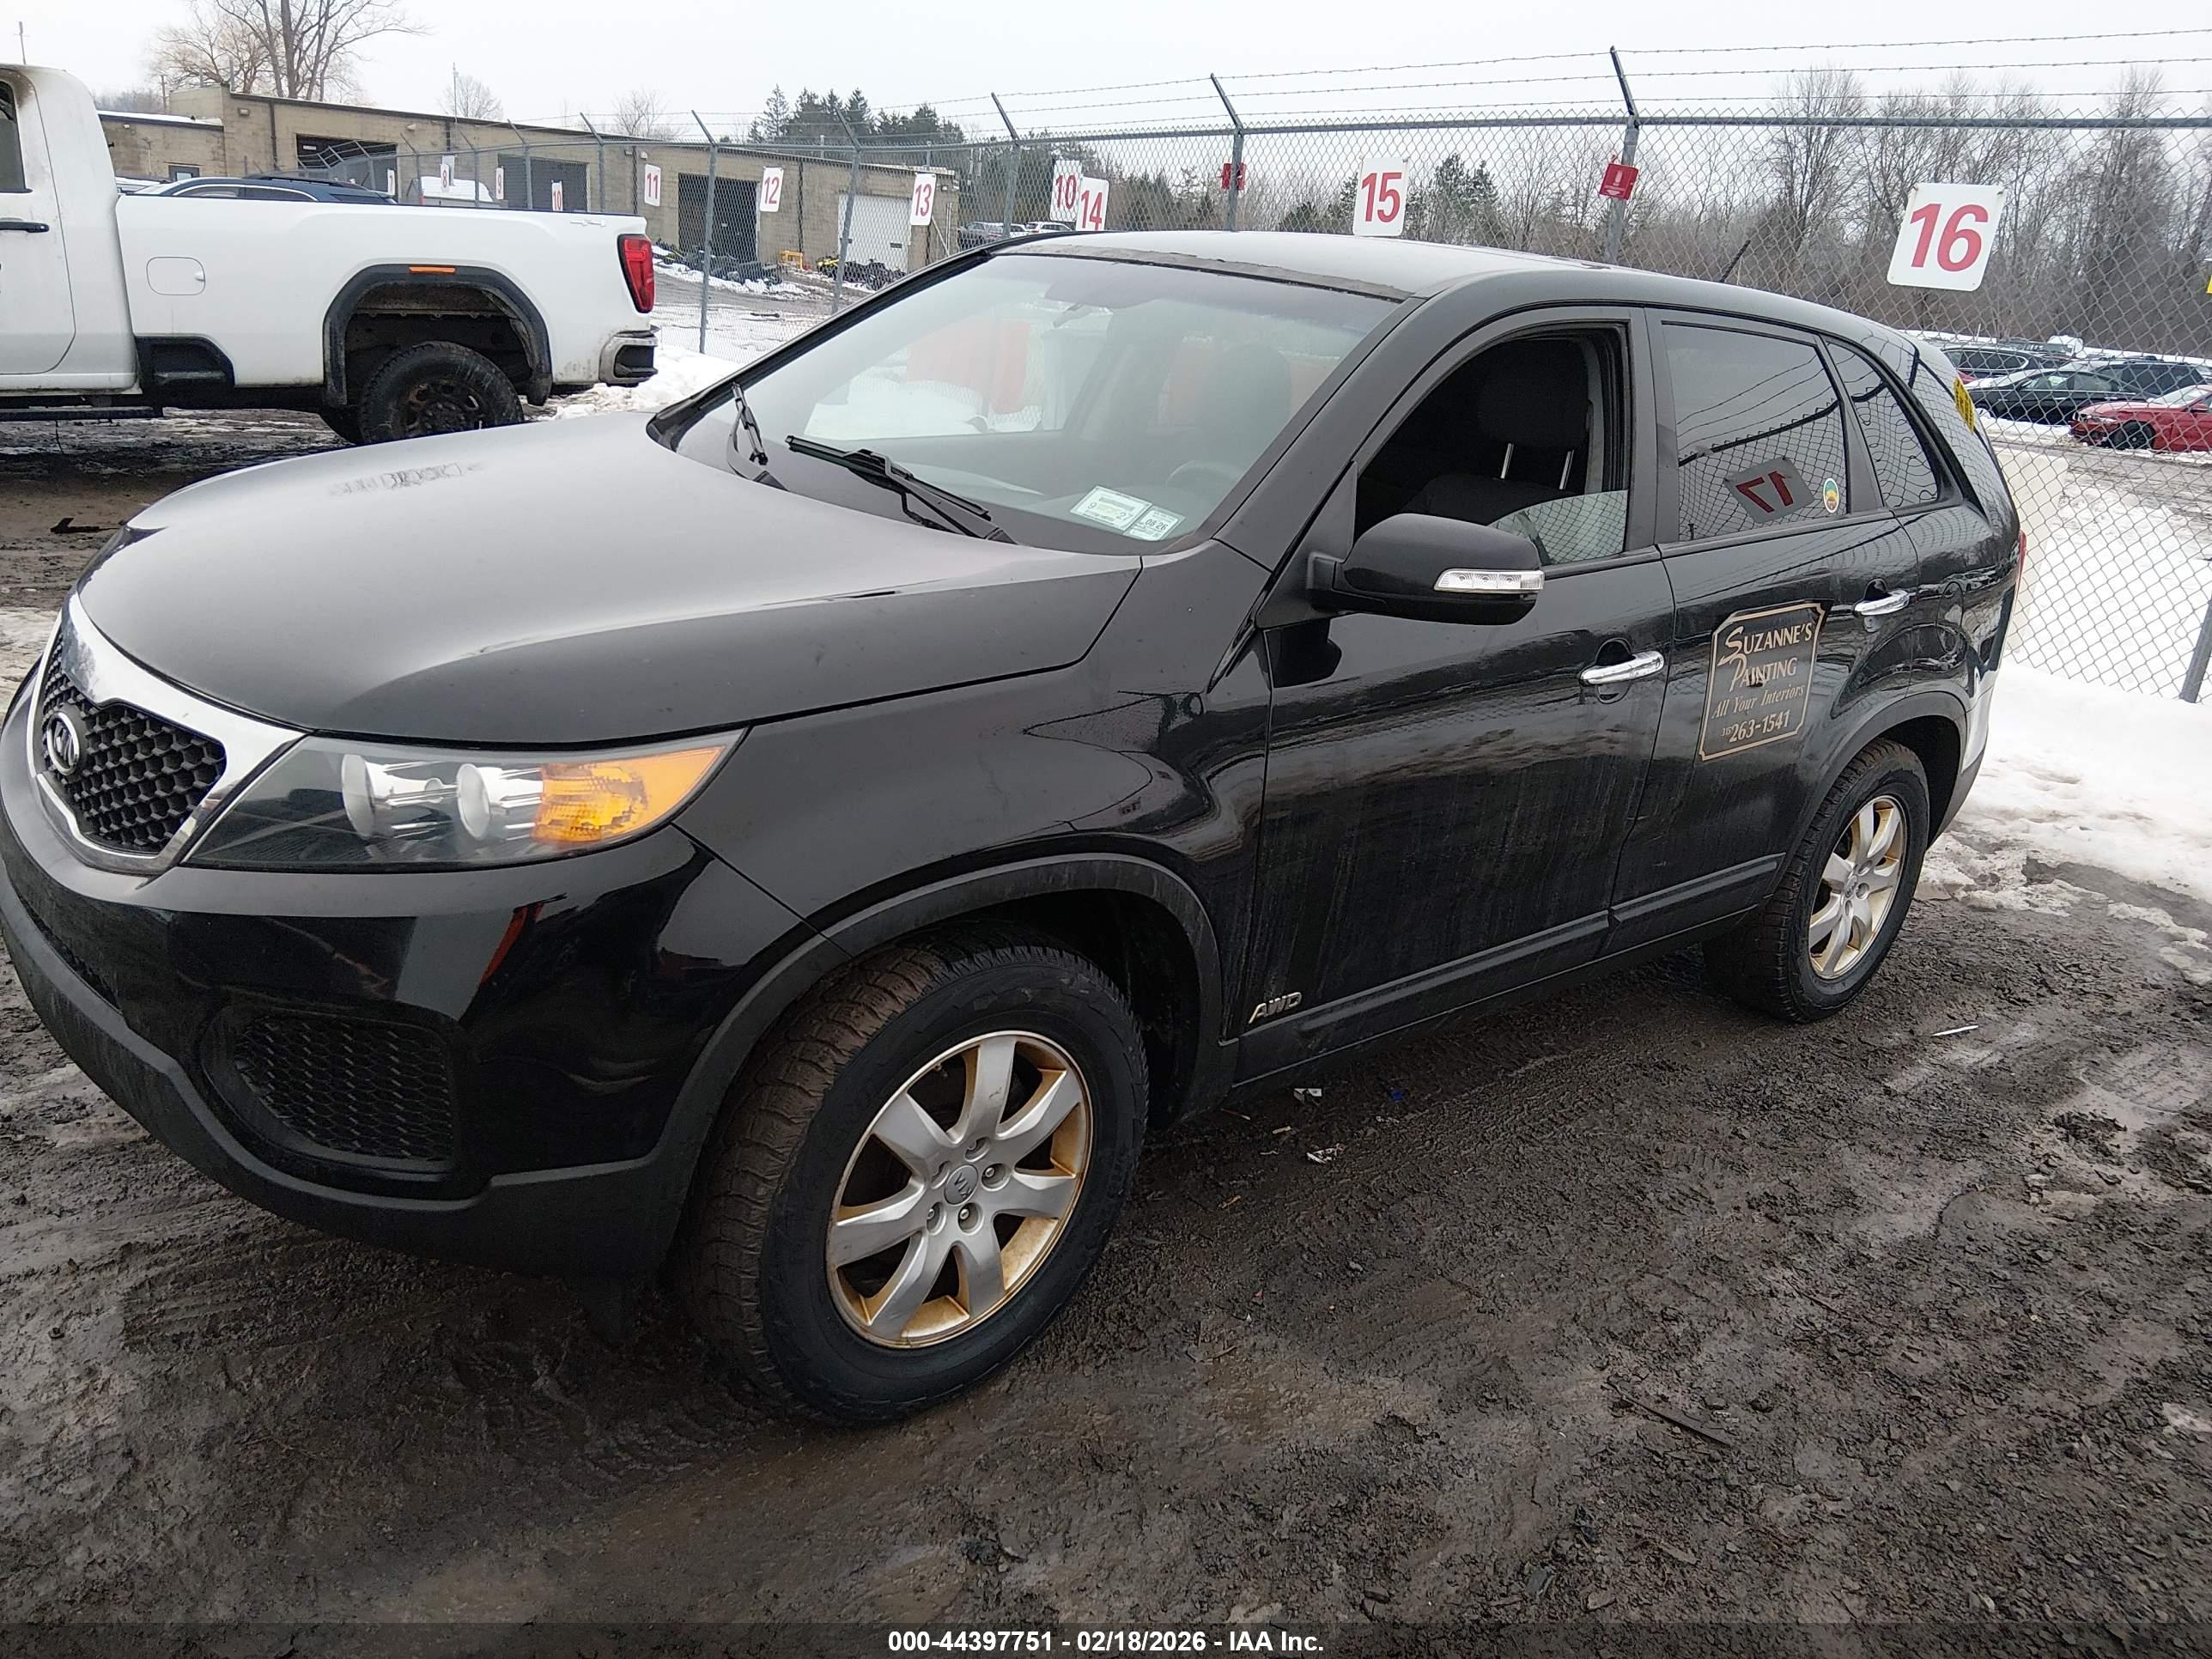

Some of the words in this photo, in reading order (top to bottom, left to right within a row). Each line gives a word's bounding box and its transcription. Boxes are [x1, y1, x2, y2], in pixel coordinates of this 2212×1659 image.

[441, 170, 447, 188] 8
[497, 173, 502, 194] 9
[646, 173, 659, 200] 11
[764, 178, 780, 204] 12
[1055, 174, 1077, 210] 10
[552, 190, 562, 211] 10
[915, 183, 933, 216] 13
[1080, 190, 1103, 231] 14
[1360, 172, 1402, 223] 15
[1910, 204, 1990, 271] 16
[1717, 623, 1813, 667] SUZANNE'S
[1729, 653, 1798, 693] PAINTING
[1711, 699, 1730, 719] All
[1733, 696, 1758, 714] Your
[1248, 992, 1302, 1024] AWD
